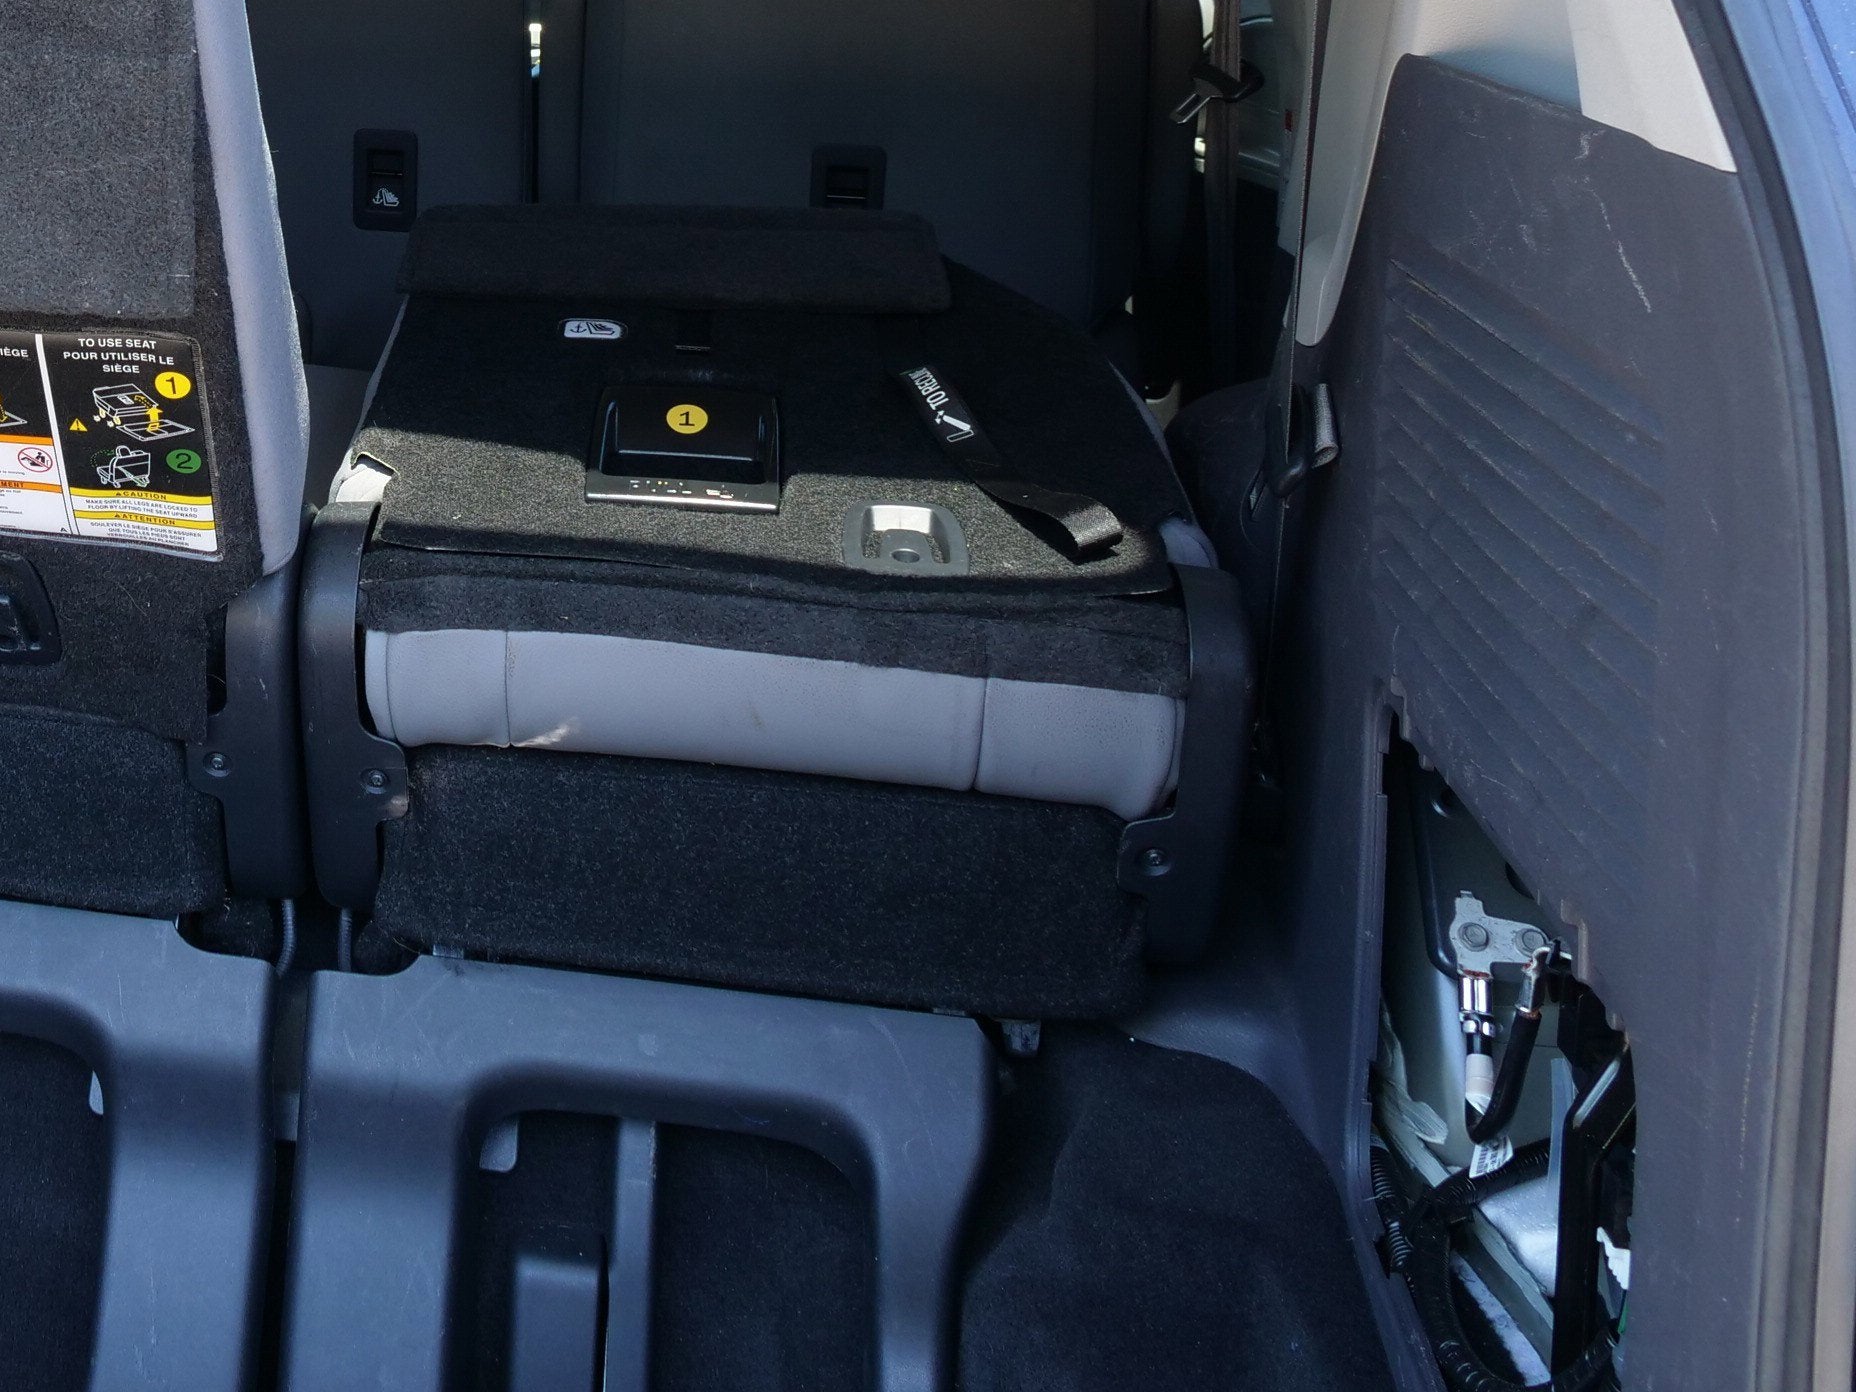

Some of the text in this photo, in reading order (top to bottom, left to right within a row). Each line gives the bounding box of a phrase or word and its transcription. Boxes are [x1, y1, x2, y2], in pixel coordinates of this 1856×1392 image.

[78, 338, 157, 350] TO USE SEAT
[63, 352, 174, 366] POUR UTILISER LE
[102, 363, 140, 374] SIÈGE
[165, 376, 177, 395] 1
[926, 390, 950, 410] TO
[678, 410, 696, 427] 1
[175, 452, 194, 470] 2
[123, 491, 167, 500] CAUTION
[122, 514, 176, 525] ATTENTION
